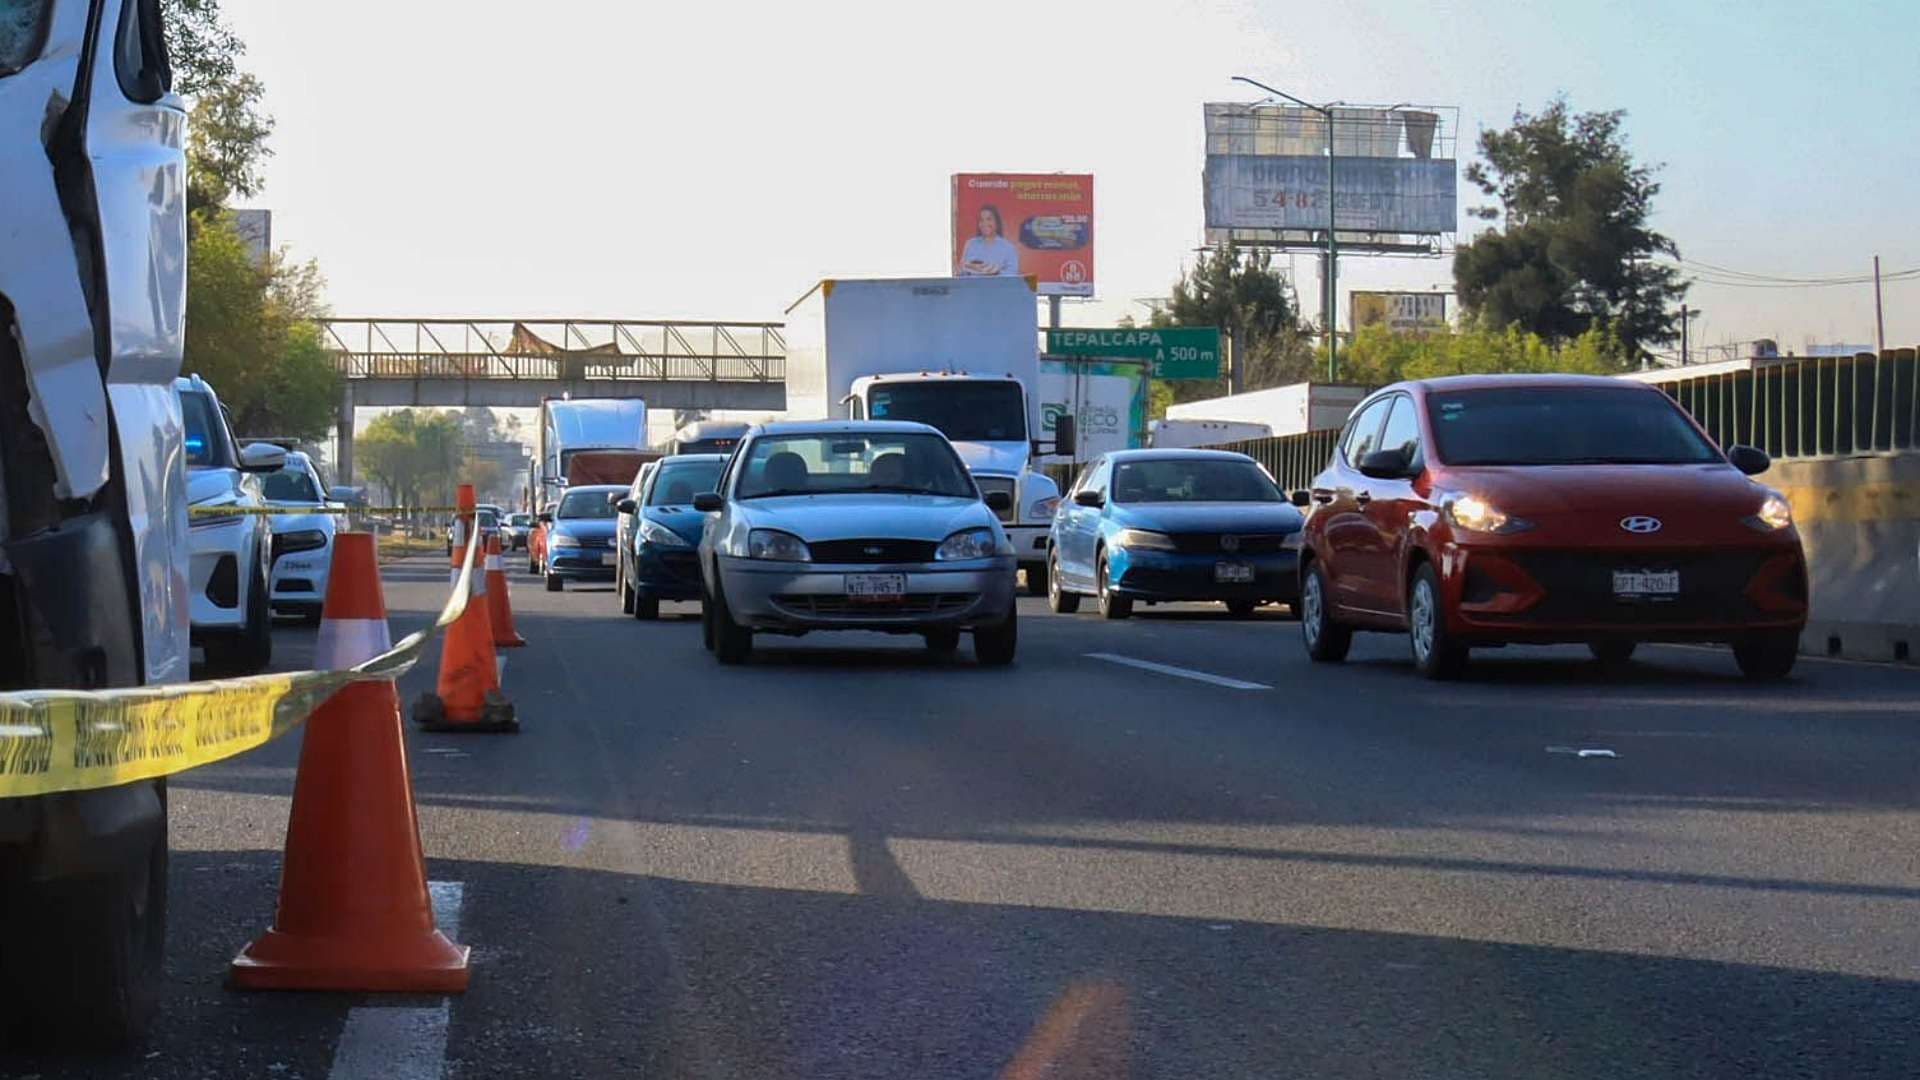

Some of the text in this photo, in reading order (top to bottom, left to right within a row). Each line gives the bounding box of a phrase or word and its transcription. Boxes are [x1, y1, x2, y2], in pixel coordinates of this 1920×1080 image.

[1052, 331, 1163, 347] TEPALCAPA
[1170, 346, 1197, 361] 500
[1200, 350, 1214, 361] m
